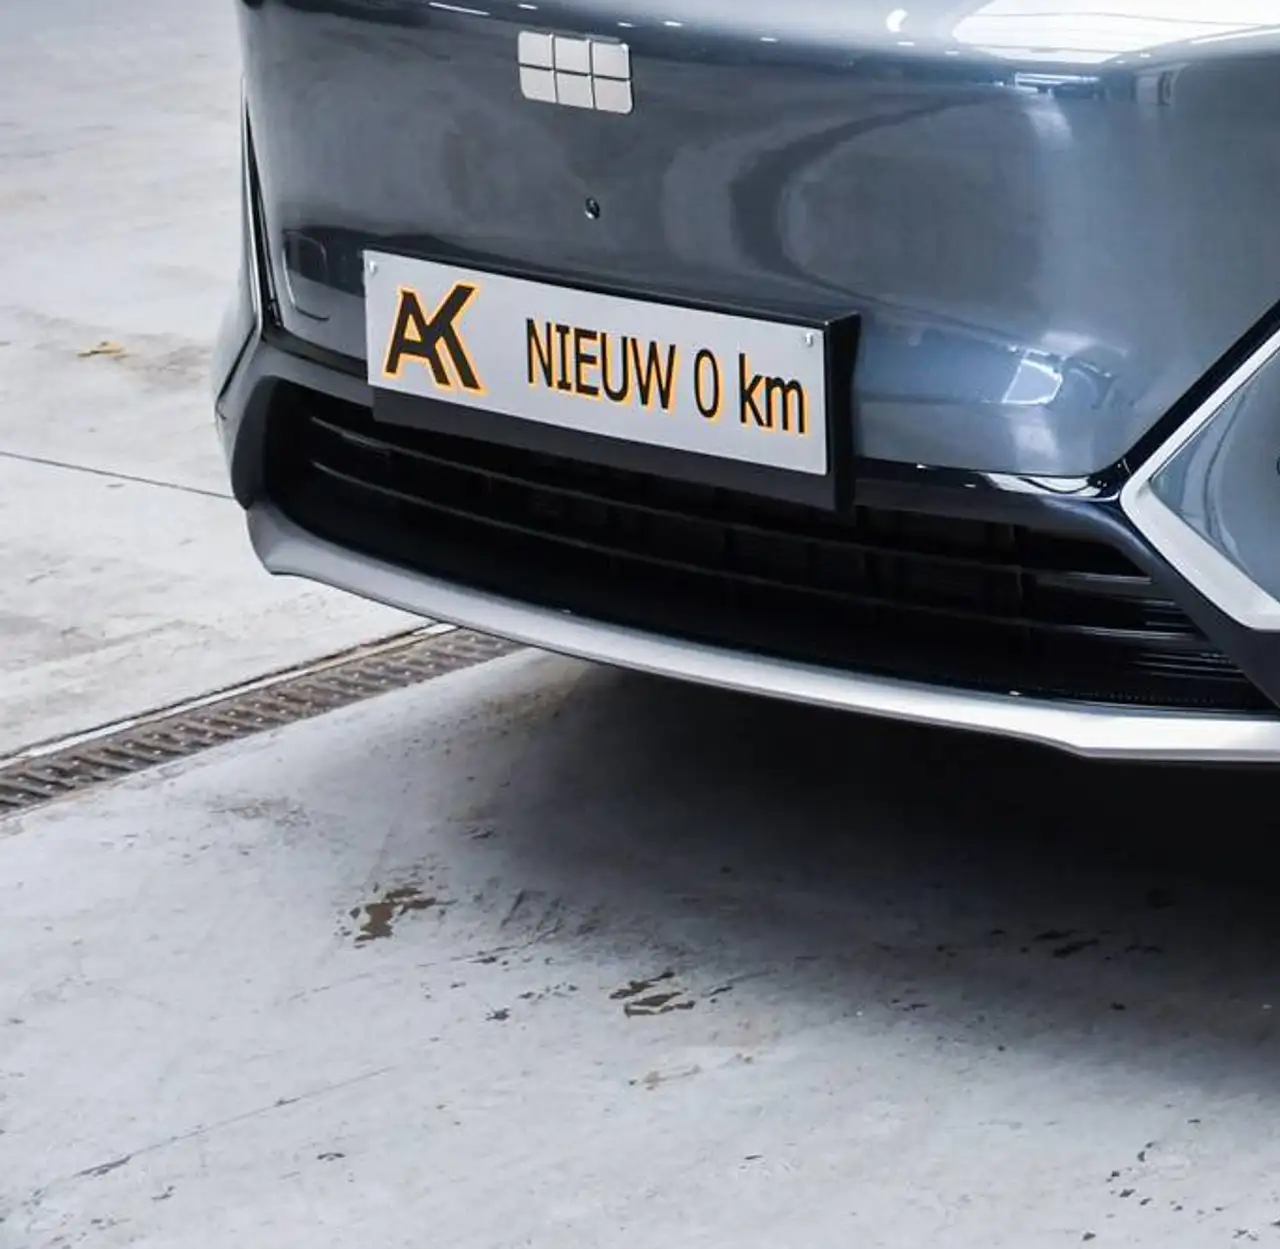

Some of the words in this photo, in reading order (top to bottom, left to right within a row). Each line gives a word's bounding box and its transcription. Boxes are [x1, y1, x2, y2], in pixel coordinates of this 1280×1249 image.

[383, 282, 487, 394] AK
[525, 317, 679, 414] NIEUW
[739, 352, 810, 437] km
